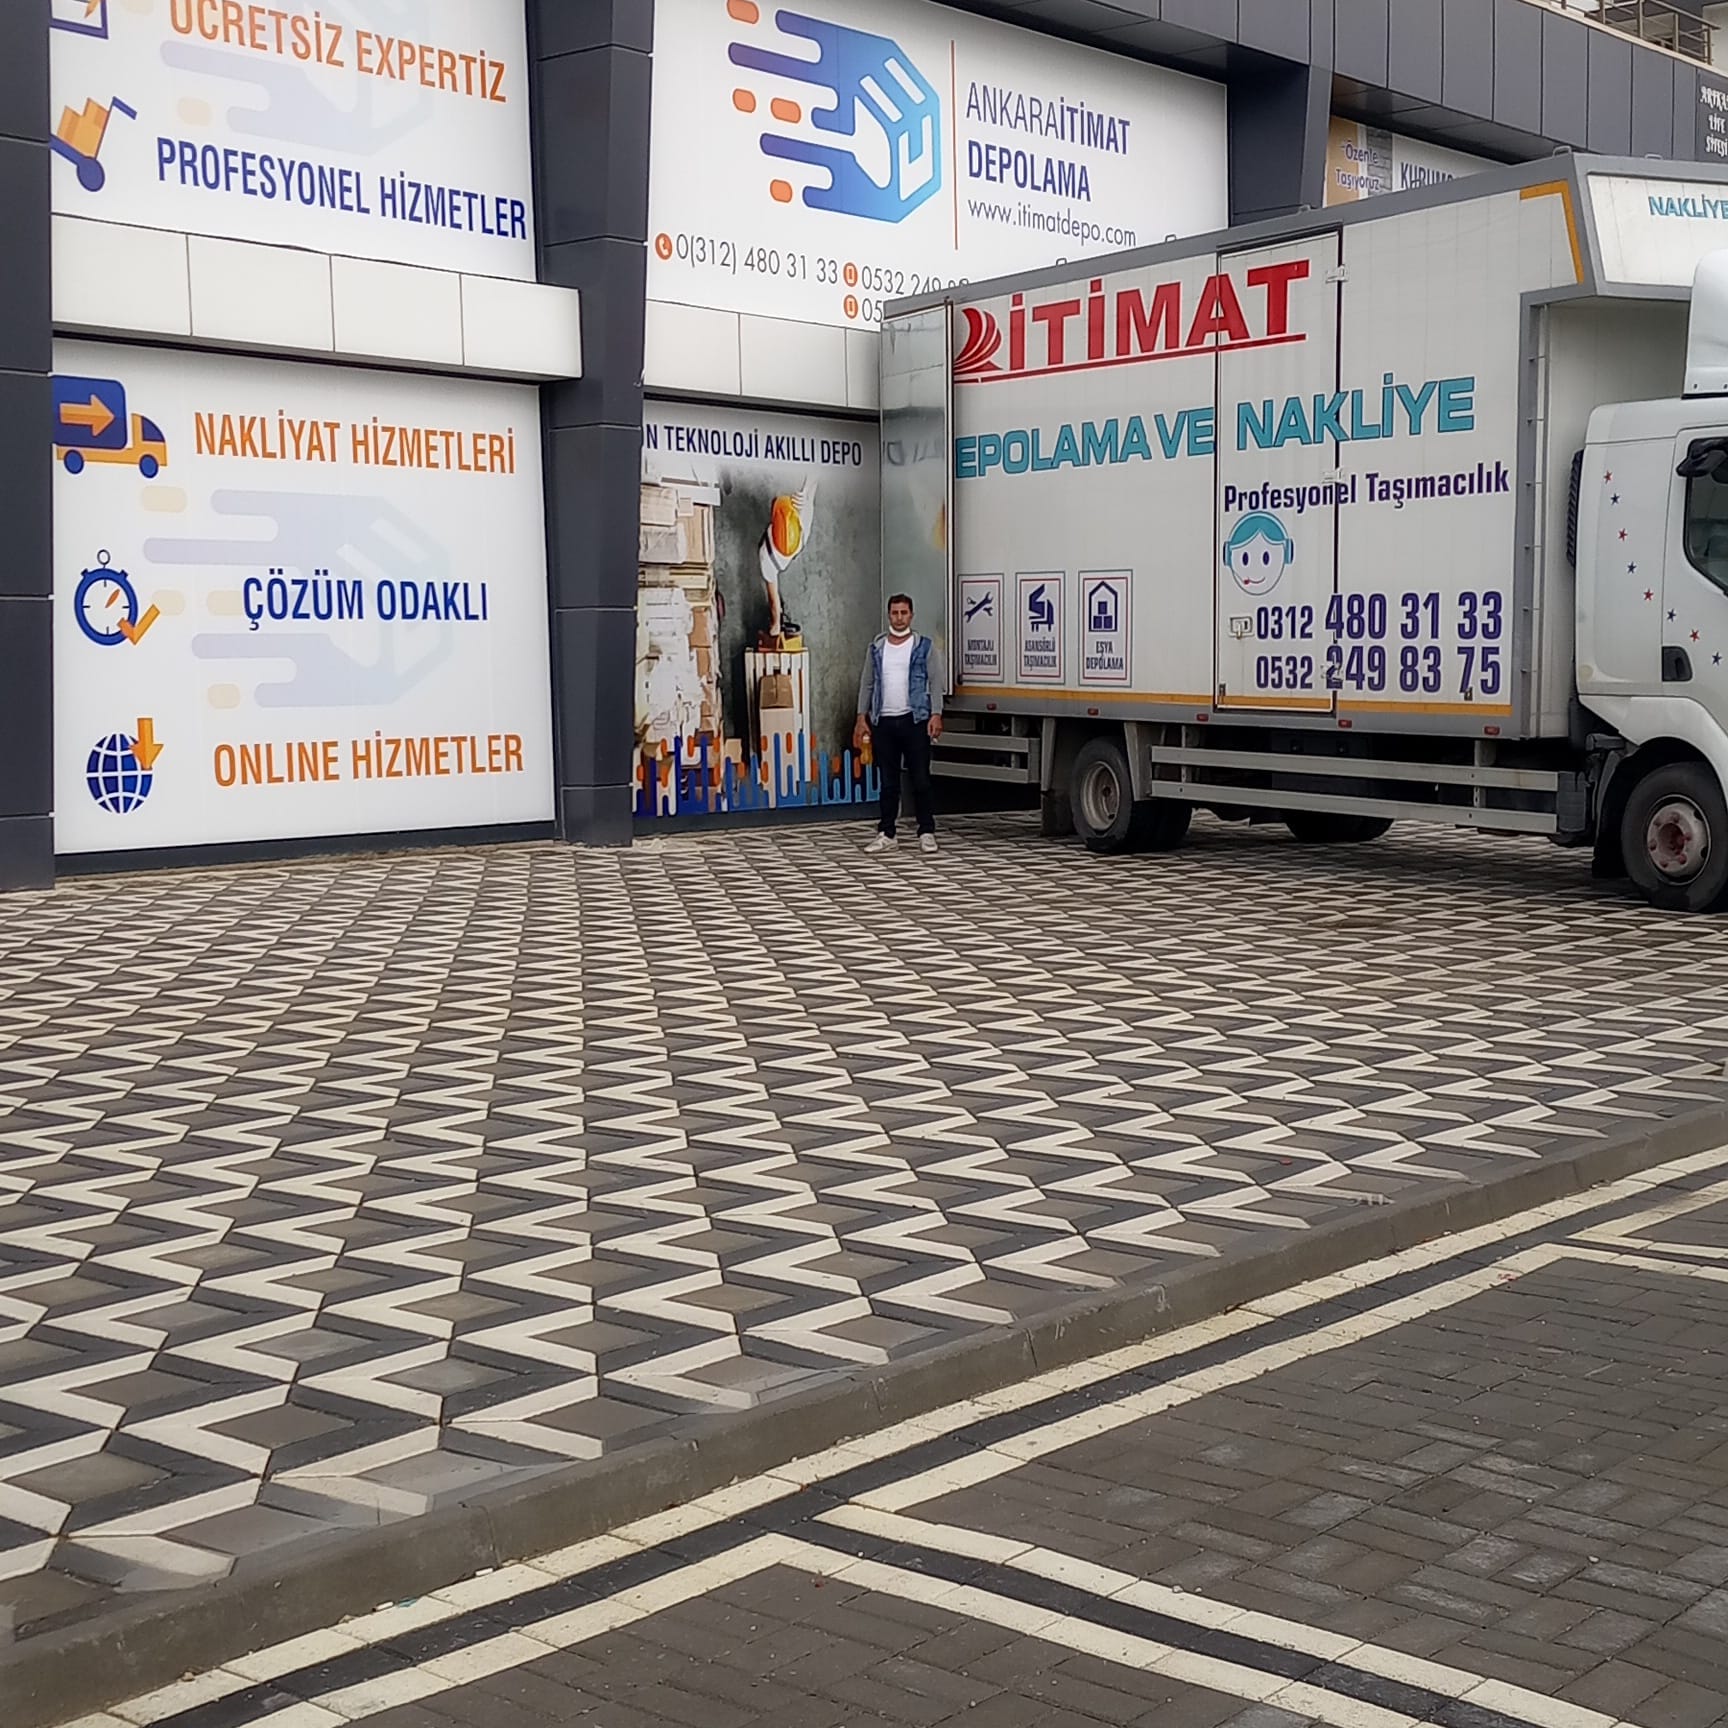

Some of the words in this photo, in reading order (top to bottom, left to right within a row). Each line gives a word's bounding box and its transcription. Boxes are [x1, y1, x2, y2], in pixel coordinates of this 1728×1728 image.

[356, 29, 506, 103] EXPERTİZ
[157, 137, 370, 214] PROFESYONEL
[380, 171, 527, 240] HİZMETLER
[968, 140, 1091, 202] DEPOLAMA
[968, 199, 1136, 247] www.itimatdepo.com
[676, 234, 736, 275] 0(312)
[744, 247, 780, 274] 480
[787, 253, 807, 279] 31
[817, 258, 838, 284] 33
[862, 265, 904, 295] 0532
[1009, 260, 1310, 370] İTİMAT
[194, 408, 340, 463] NAKLİYAT
[351, 416, 515, 474] HİZMETLERİ
[664, 425, 759, 459] TEKNOLOJİ
[764, 435, 814, 463] AKILLI
[821, 440, 862, 466] DEPO
[1154, 407, 1213, 459] VE
[1237, 372, 1476, 452] NAKLİYE
[1224, 474, 1356, 513] Profesyonel
[1366, 461, 1510, 509] Taşımacılık
[243, 569, 364, 630] ÇÖZÜM
[376, 579, 488, 622] ODAKLI
[1256, 605, 1313, 640] 0312
[1325, 593, 1387, 640] 480
[1400, 592, 1440, 640] 31
[1457, 591, 1502, 640] 33
[1086, 657, 1123, 670] DEPOLAMA
[1256, 655, 1313, 689] 0532
[1325, 645, 1386, 691] 249
[1400, 645, 1441, 692] 83
[1457, 646, 1500, 694] 75
[214, 739, 339, 788] ONLINE
[351, 731, 523, 779] HİZMETLER
